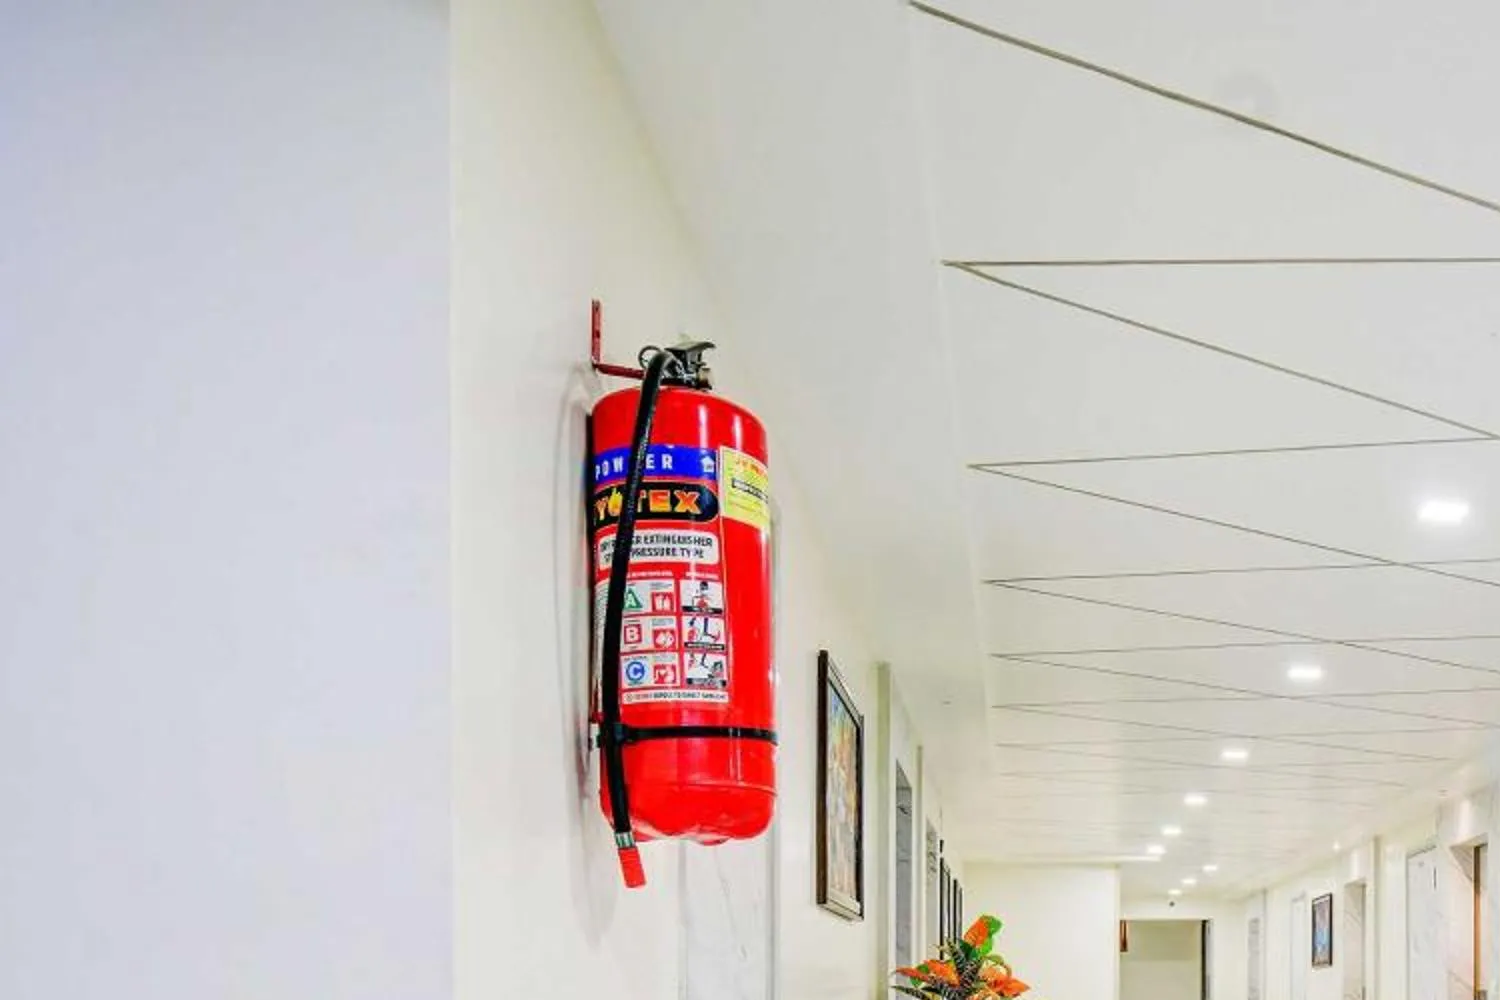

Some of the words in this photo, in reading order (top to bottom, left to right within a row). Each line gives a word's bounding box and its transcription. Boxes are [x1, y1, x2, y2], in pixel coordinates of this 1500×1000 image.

[595, 453, 674, 481] POWER
[644, 534, 713, 547] EXTINGUISHER
[626, 626, 640, 642] B
